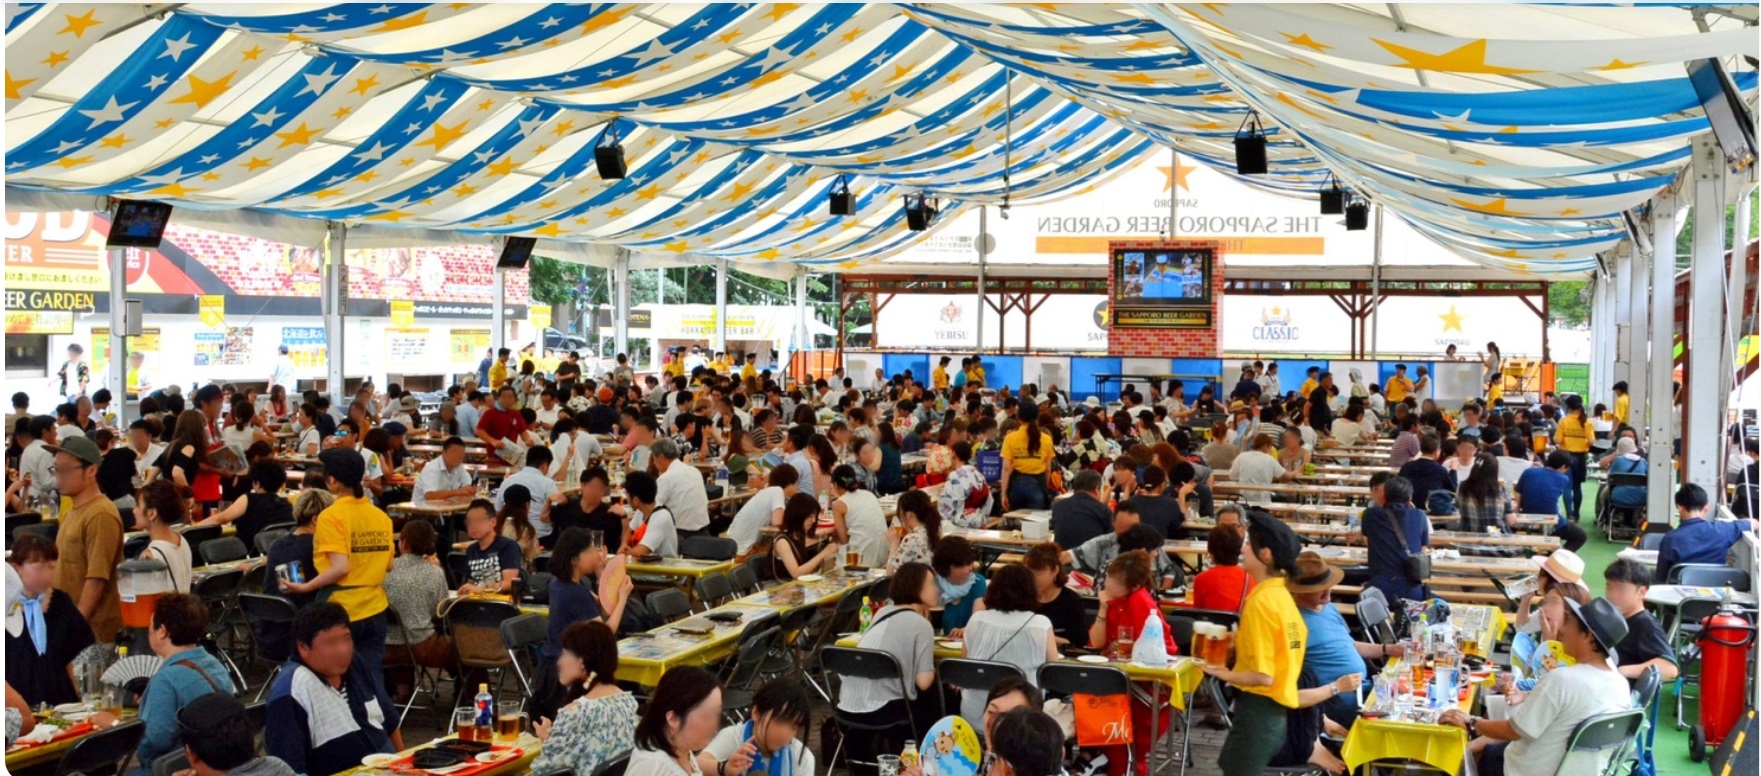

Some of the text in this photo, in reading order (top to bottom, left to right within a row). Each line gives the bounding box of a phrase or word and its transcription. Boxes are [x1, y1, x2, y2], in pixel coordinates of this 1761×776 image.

[30, 291, 95, 310] GARDEN
[934, 330, 968, 340] YEBISU
[1252, 326, 1299, 341] CLASSIC
